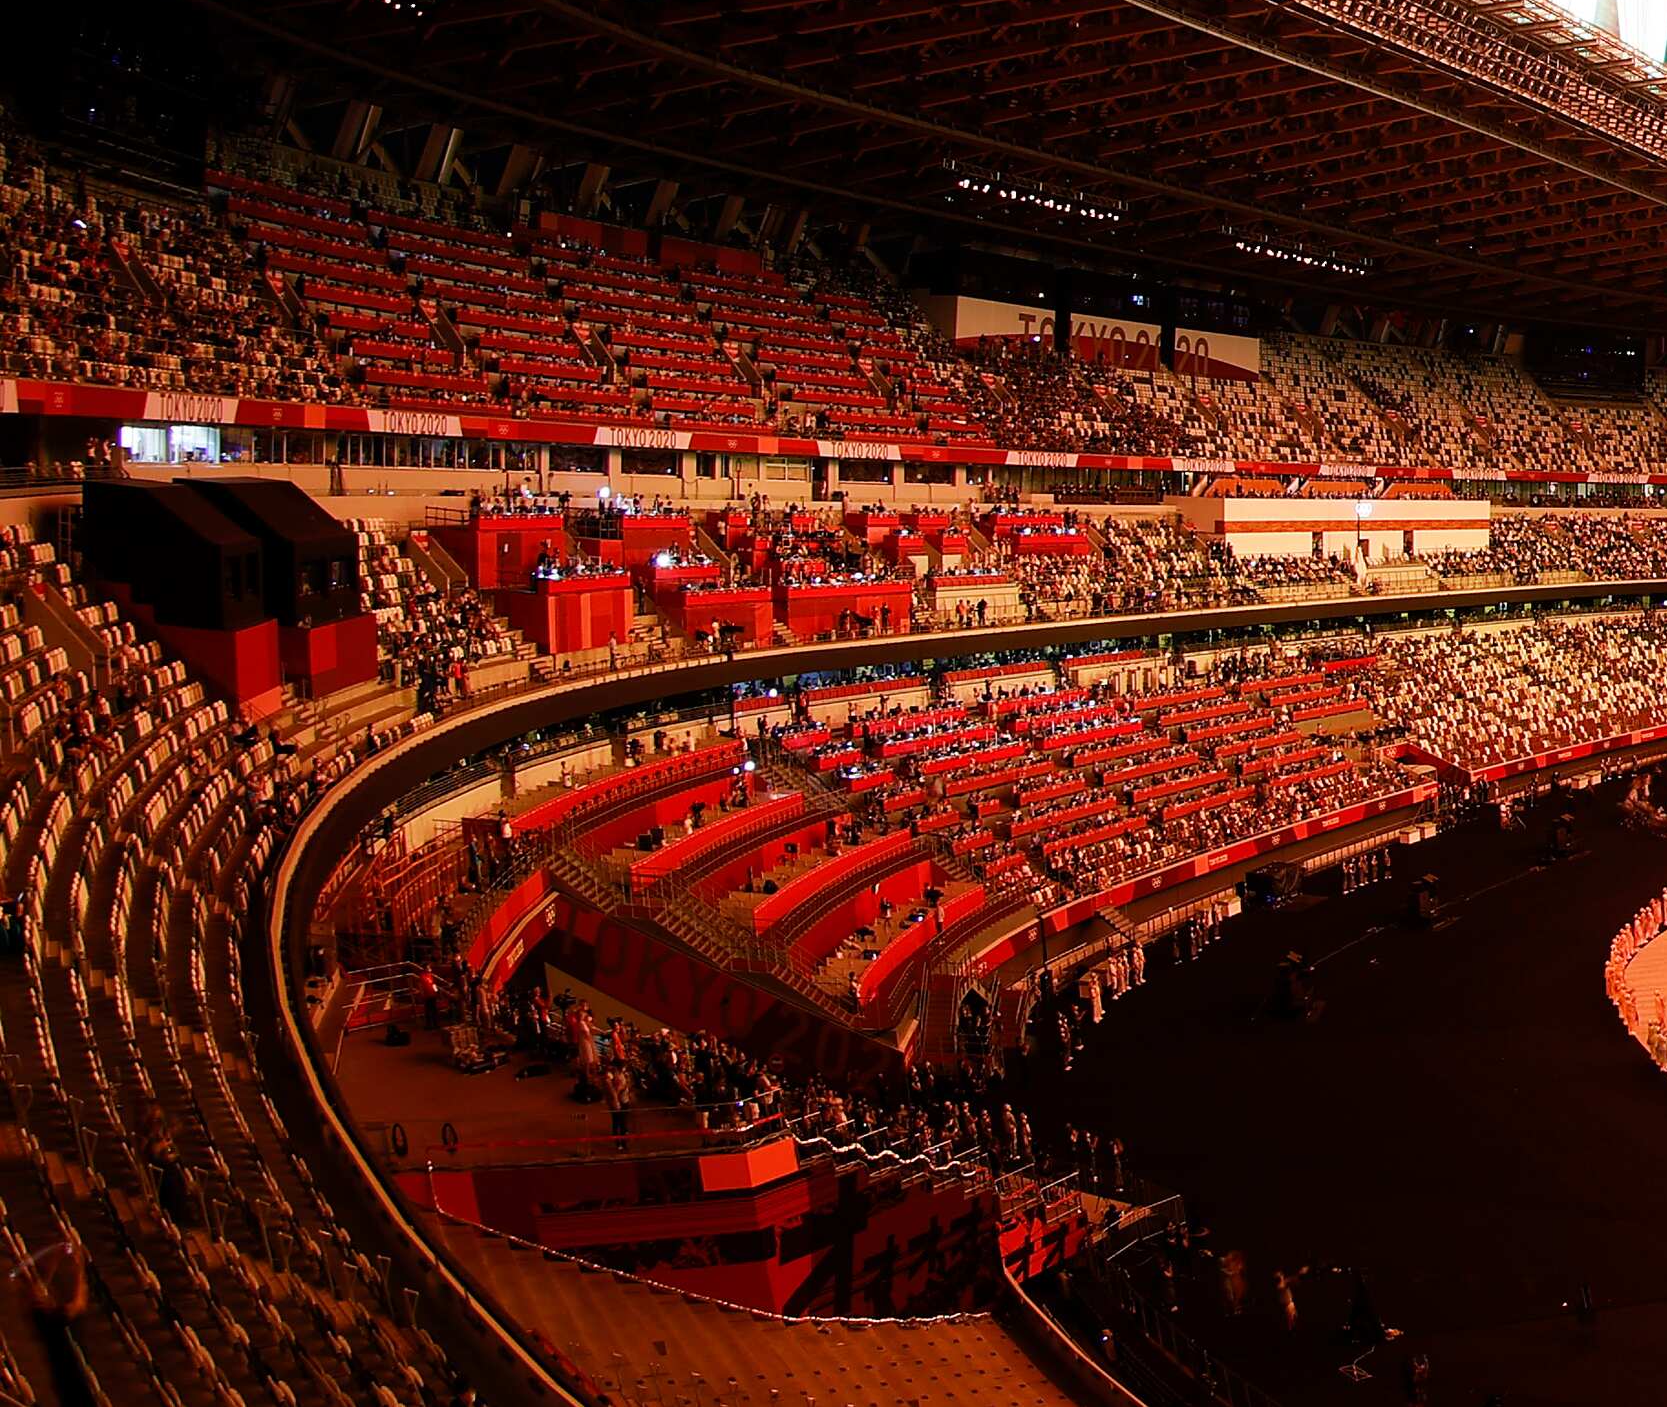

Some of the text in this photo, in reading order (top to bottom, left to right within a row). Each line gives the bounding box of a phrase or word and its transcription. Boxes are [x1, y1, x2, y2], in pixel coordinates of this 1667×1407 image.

[160, 393, 223, 422] TOKYO 2020
[383, 412, 447, 436] TOKYO 2020
[610, 429, 676, 448] TOKYO 2020
[832, 443, 888, 459] TOKYO 2020
[1019, 453, 1067, 466] TOKYO 2020
